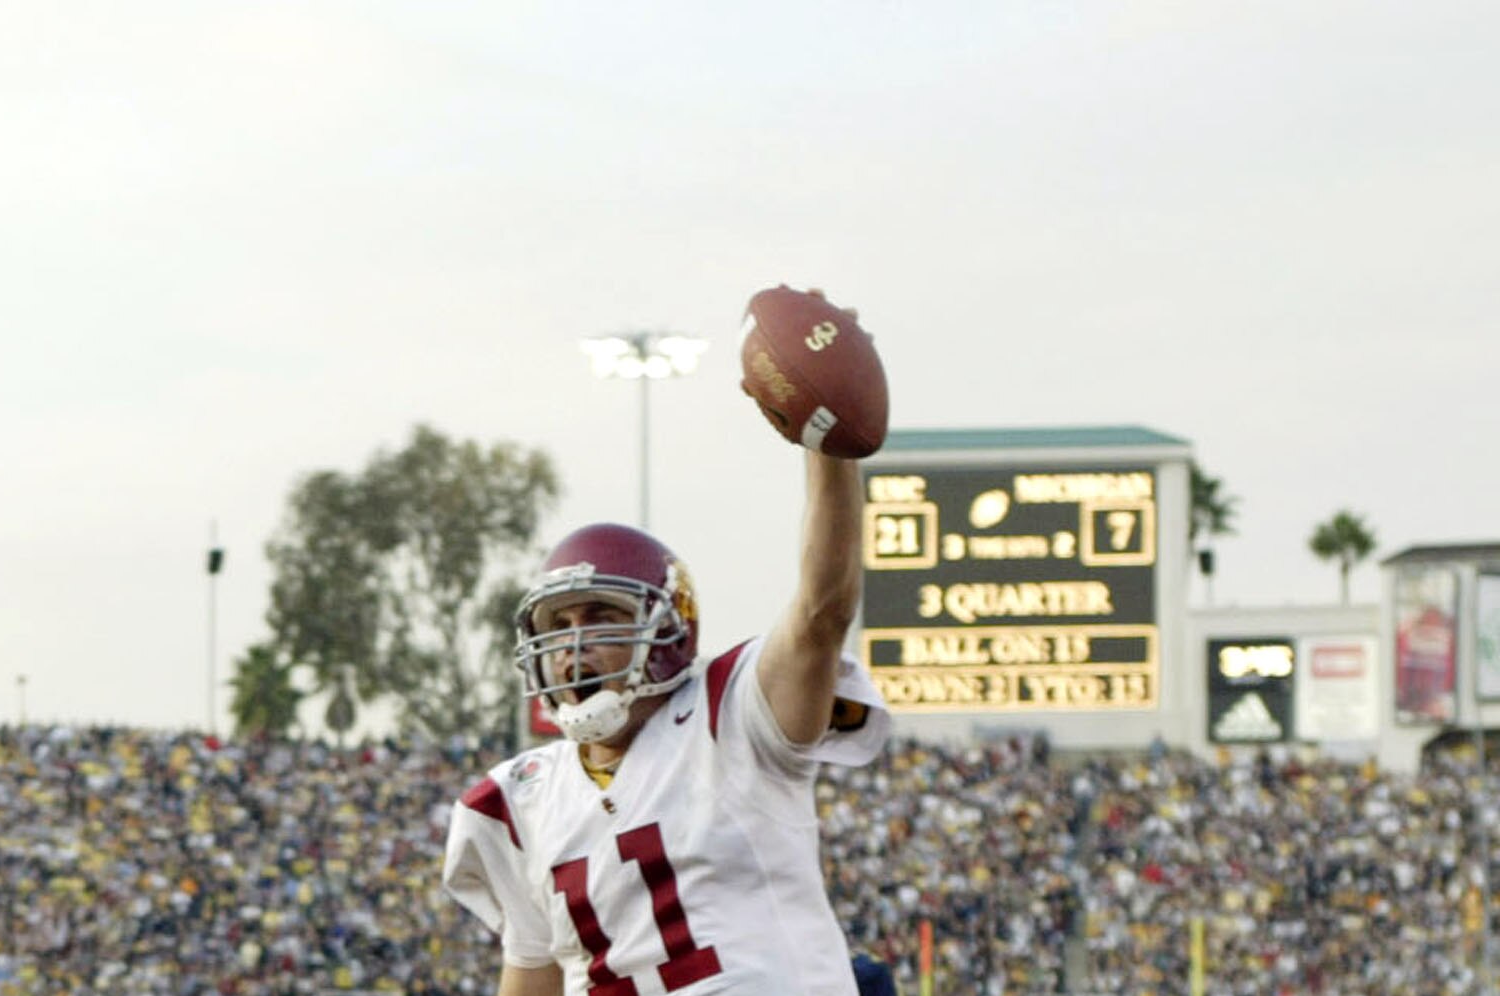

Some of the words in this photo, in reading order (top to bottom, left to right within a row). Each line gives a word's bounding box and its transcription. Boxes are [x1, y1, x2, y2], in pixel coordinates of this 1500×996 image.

[876, 516, 918, 554] 21
[1107, 511, 1136, 550] 7
[920, 584, 942, 618] 3
[945, 581, 1115, 623] QUARTER
[903, 637, 988, 665] BALL
